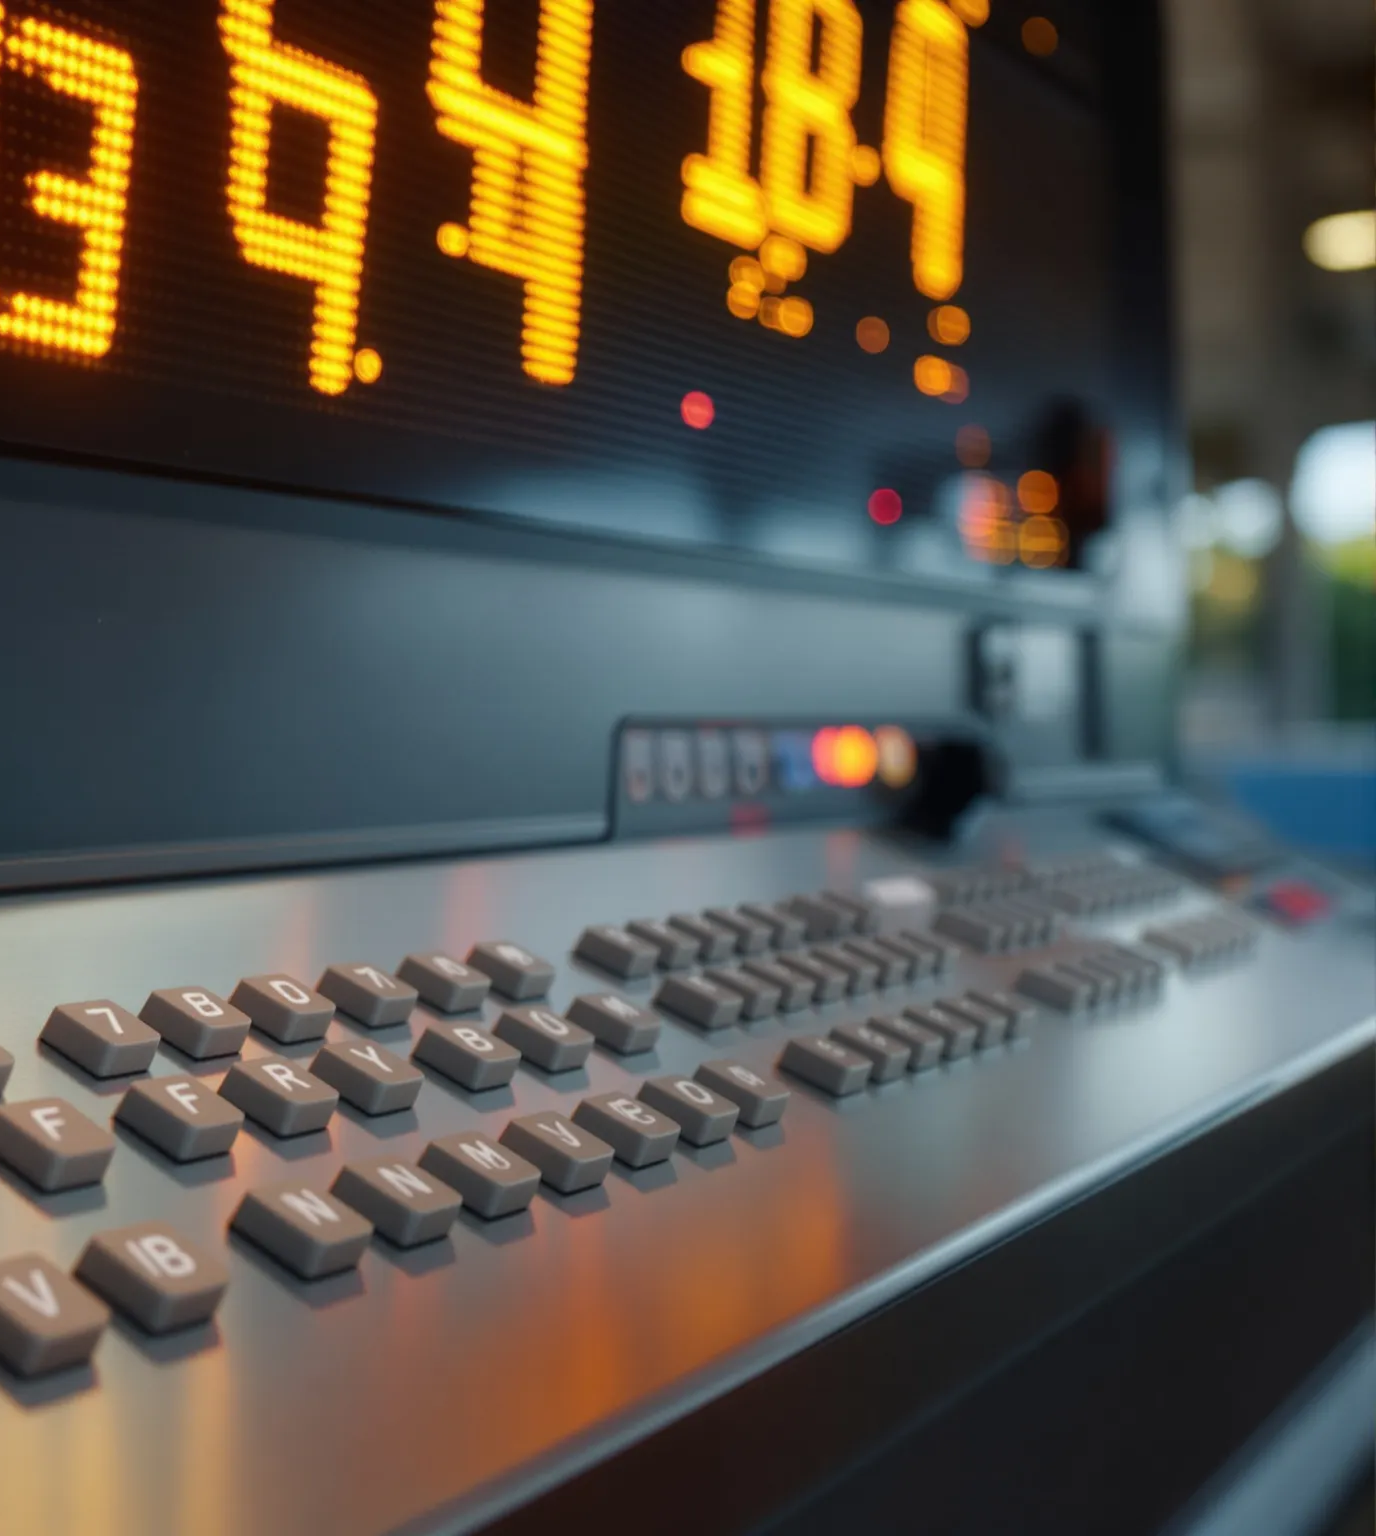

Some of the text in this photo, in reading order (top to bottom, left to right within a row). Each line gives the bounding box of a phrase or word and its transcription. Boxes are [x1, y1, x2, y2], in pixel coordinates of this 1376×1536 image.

[85, 1006, 124, 1035] 7
[30, 1106, 66, 1141] F
[165, 1082, 200, 1115] F
[261, 1063, 312, 1092] R
[3, 1269, 60, 1318] V
